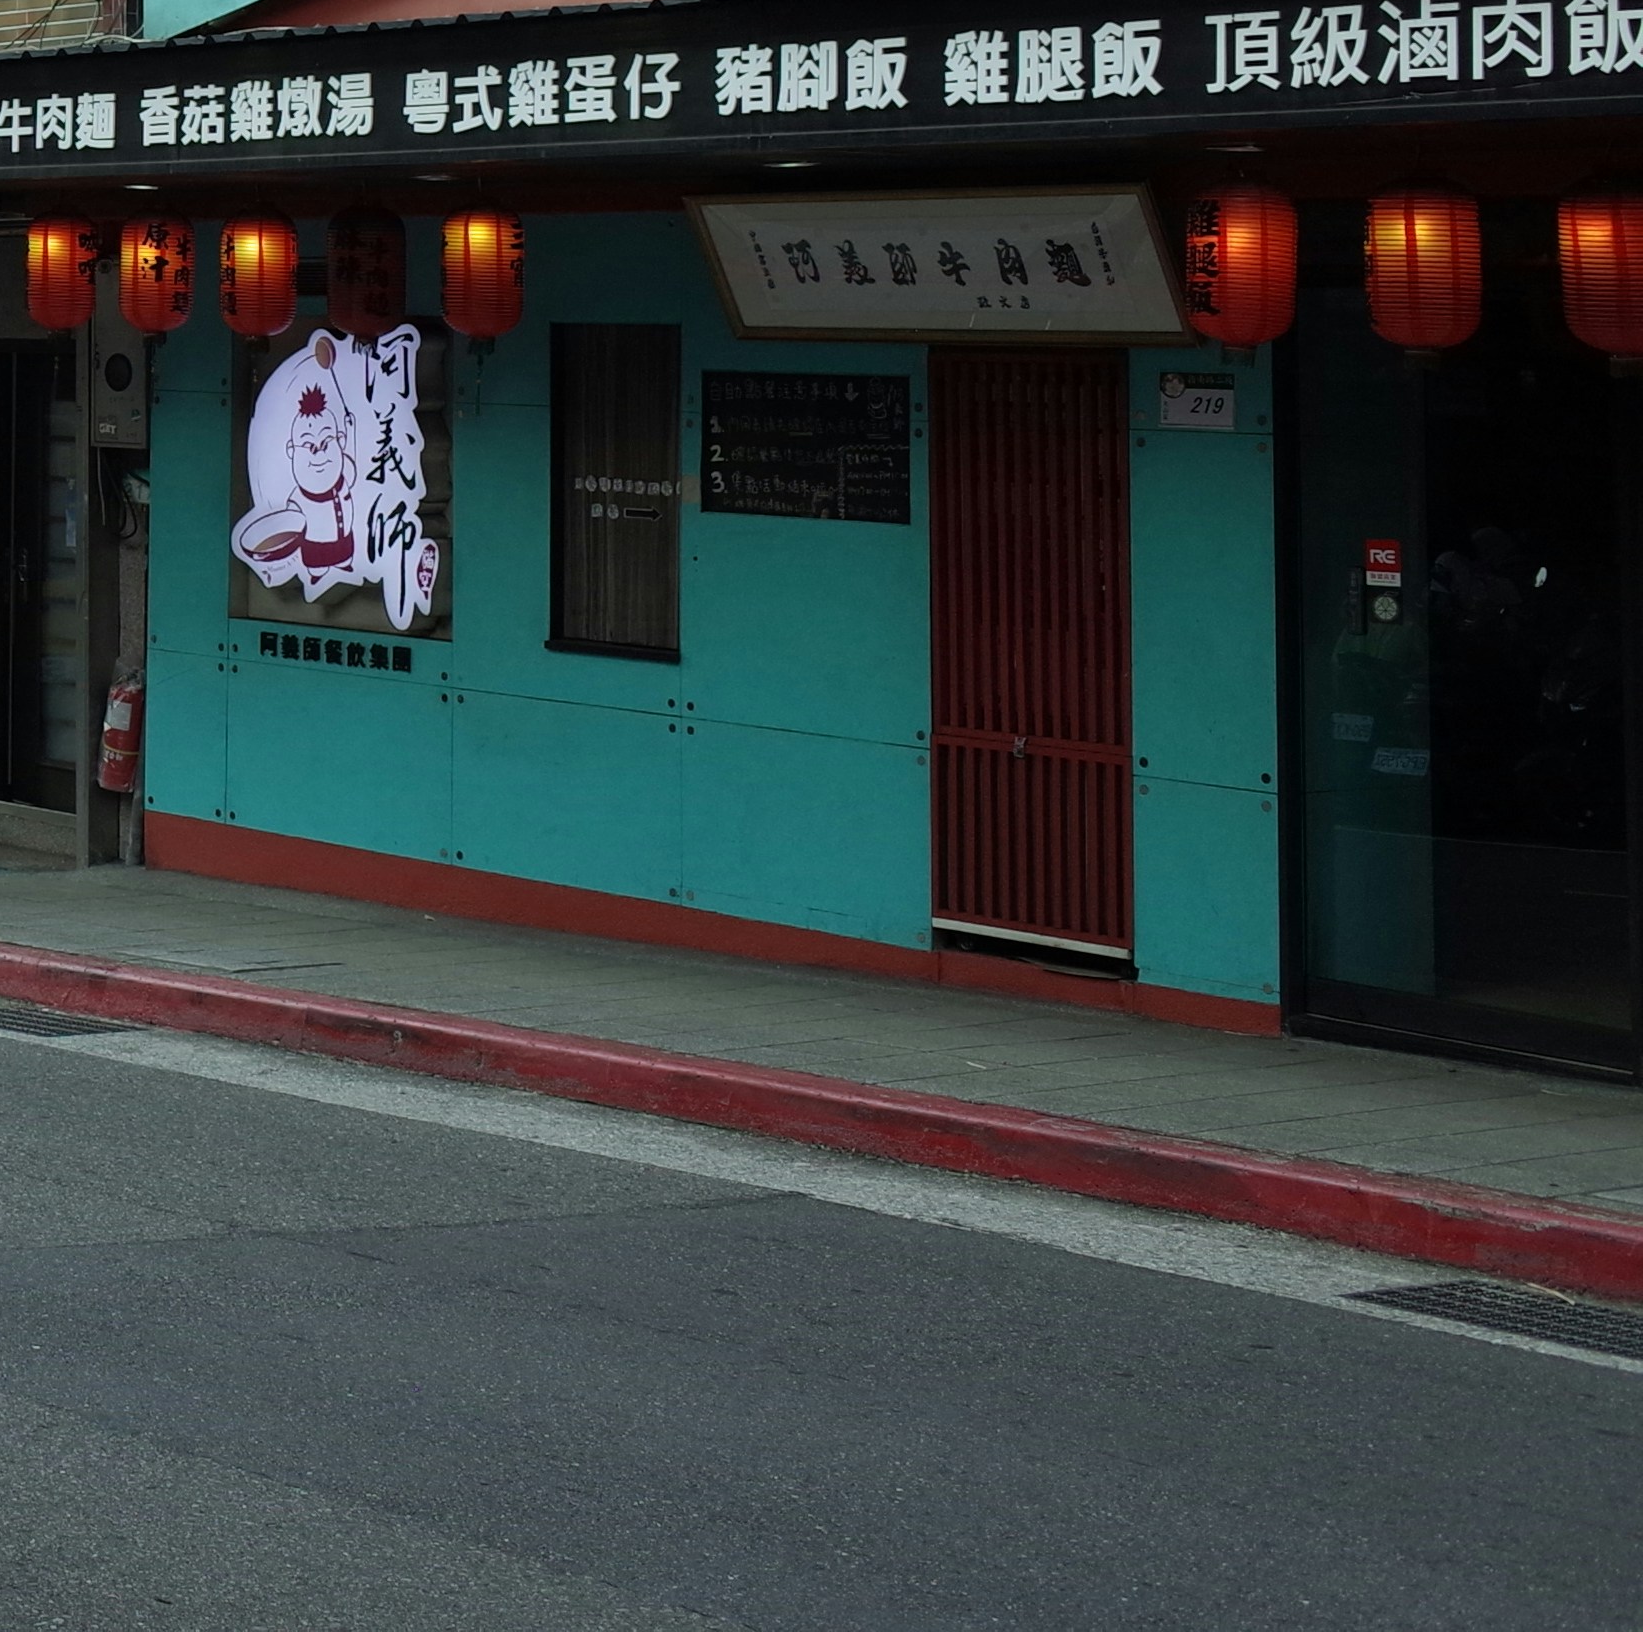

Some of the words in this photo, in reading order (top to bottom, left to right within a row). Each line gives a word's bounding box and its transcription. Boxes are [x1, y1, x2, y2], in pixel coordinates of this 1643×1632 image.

[138, 71, 375, 148] 香菇雞燉湯
[403, 52, 682, 135] 粵式雞蛋仔
[715, 37, 909, 117] 豬腳飯
[943, 19, 1164, 107] 雞腿飯
[1190, 397, 1224, 414] 219
[260, 631, 412, 673] 阿義師餐飲集團
